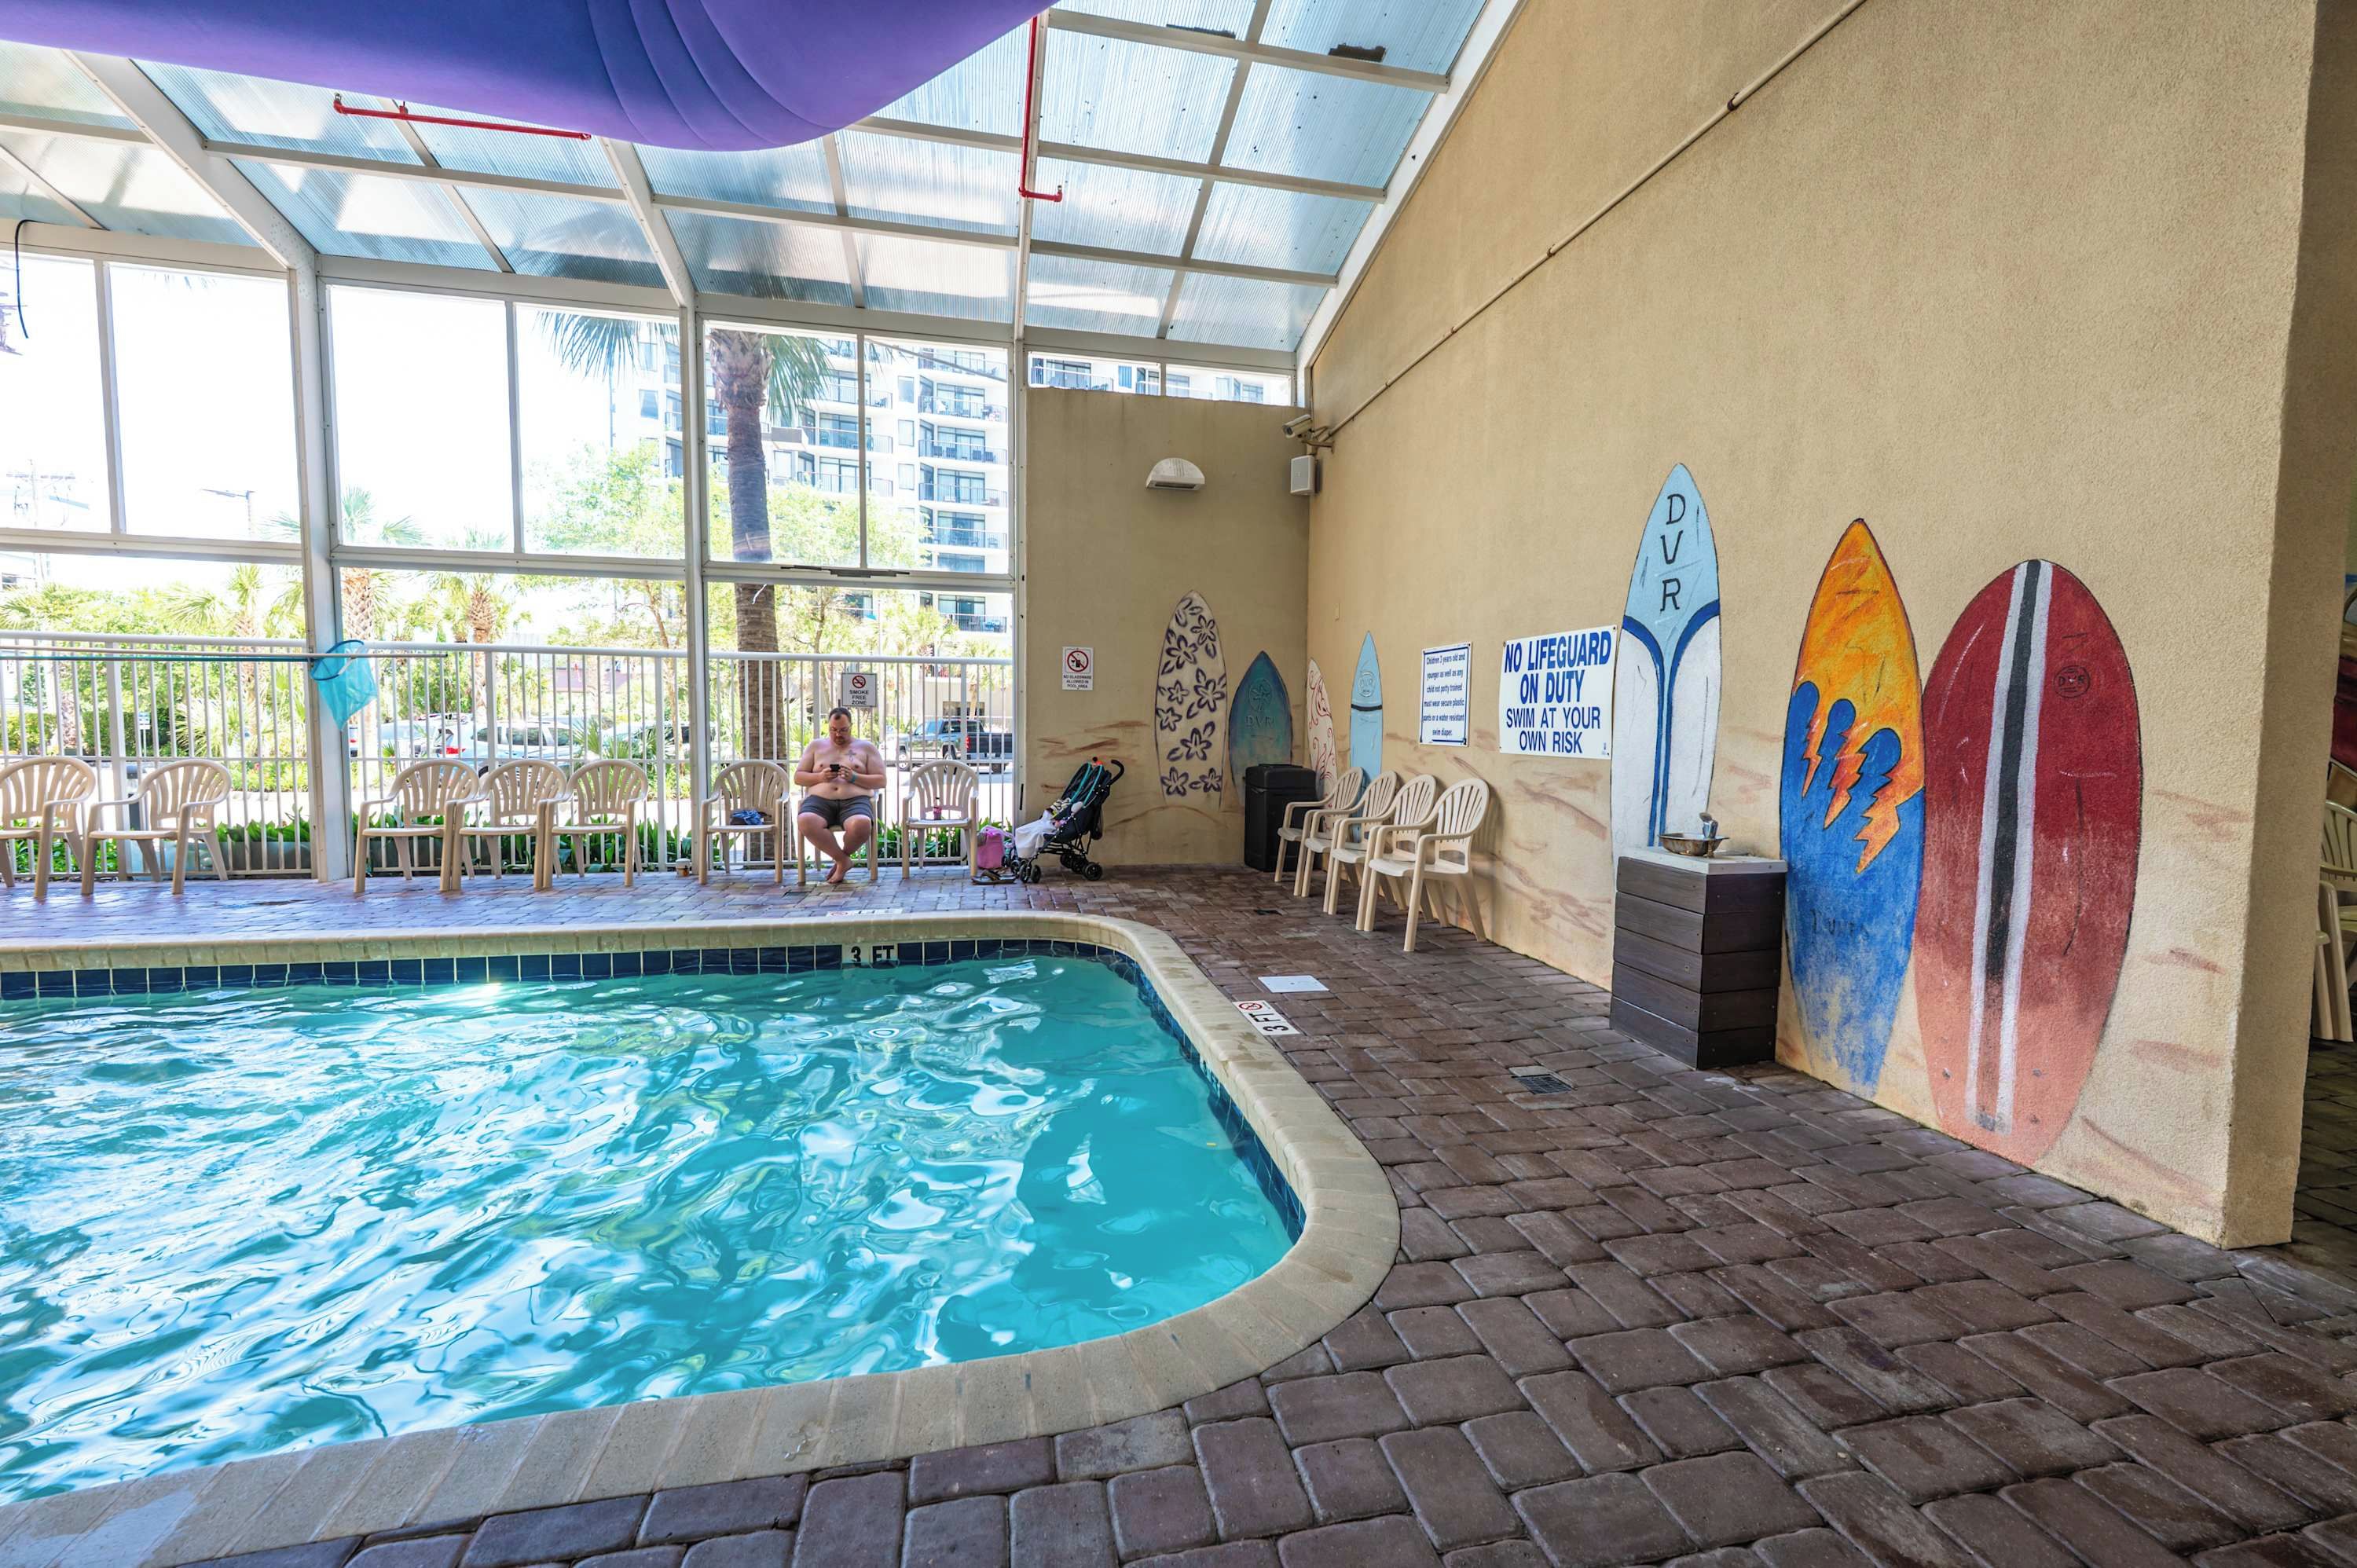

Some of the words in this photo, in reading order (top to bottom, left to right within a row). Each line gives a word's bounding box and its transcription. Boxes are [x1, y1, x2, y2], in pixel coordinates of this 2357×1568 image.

[1660, 493, 1685, 611] DVR
[1427, 655, 1439, 665] Children
[1442, 655, 1452, 665] years
[1505, 642, 1523, 673] NO
[1527, 631, 1611, 671] LIFEGUARD
[1427, 672, 1439, 681] younger
[1441, 683, 1450, 694] potty
[1450, 683, 1462, 691] trained
[1519, 673, 1539, 705] ON
[1545, 669, 1585, 704] DUTY
[1453, 698, 1464, 708] plastic
[1506, 708, 1534, 728] SWIM
[1540, 707, 1557, 728] AT
[1563, 706, 1600, 729] YOUR
[1519, 730, 1546, 752] OWN
[1552, 731, 1582, 754] RISK
[851, 945, 862, 962] 3
[872, 945, 895, 962] FT
[1248, 1013, 1282, 1023] FT
